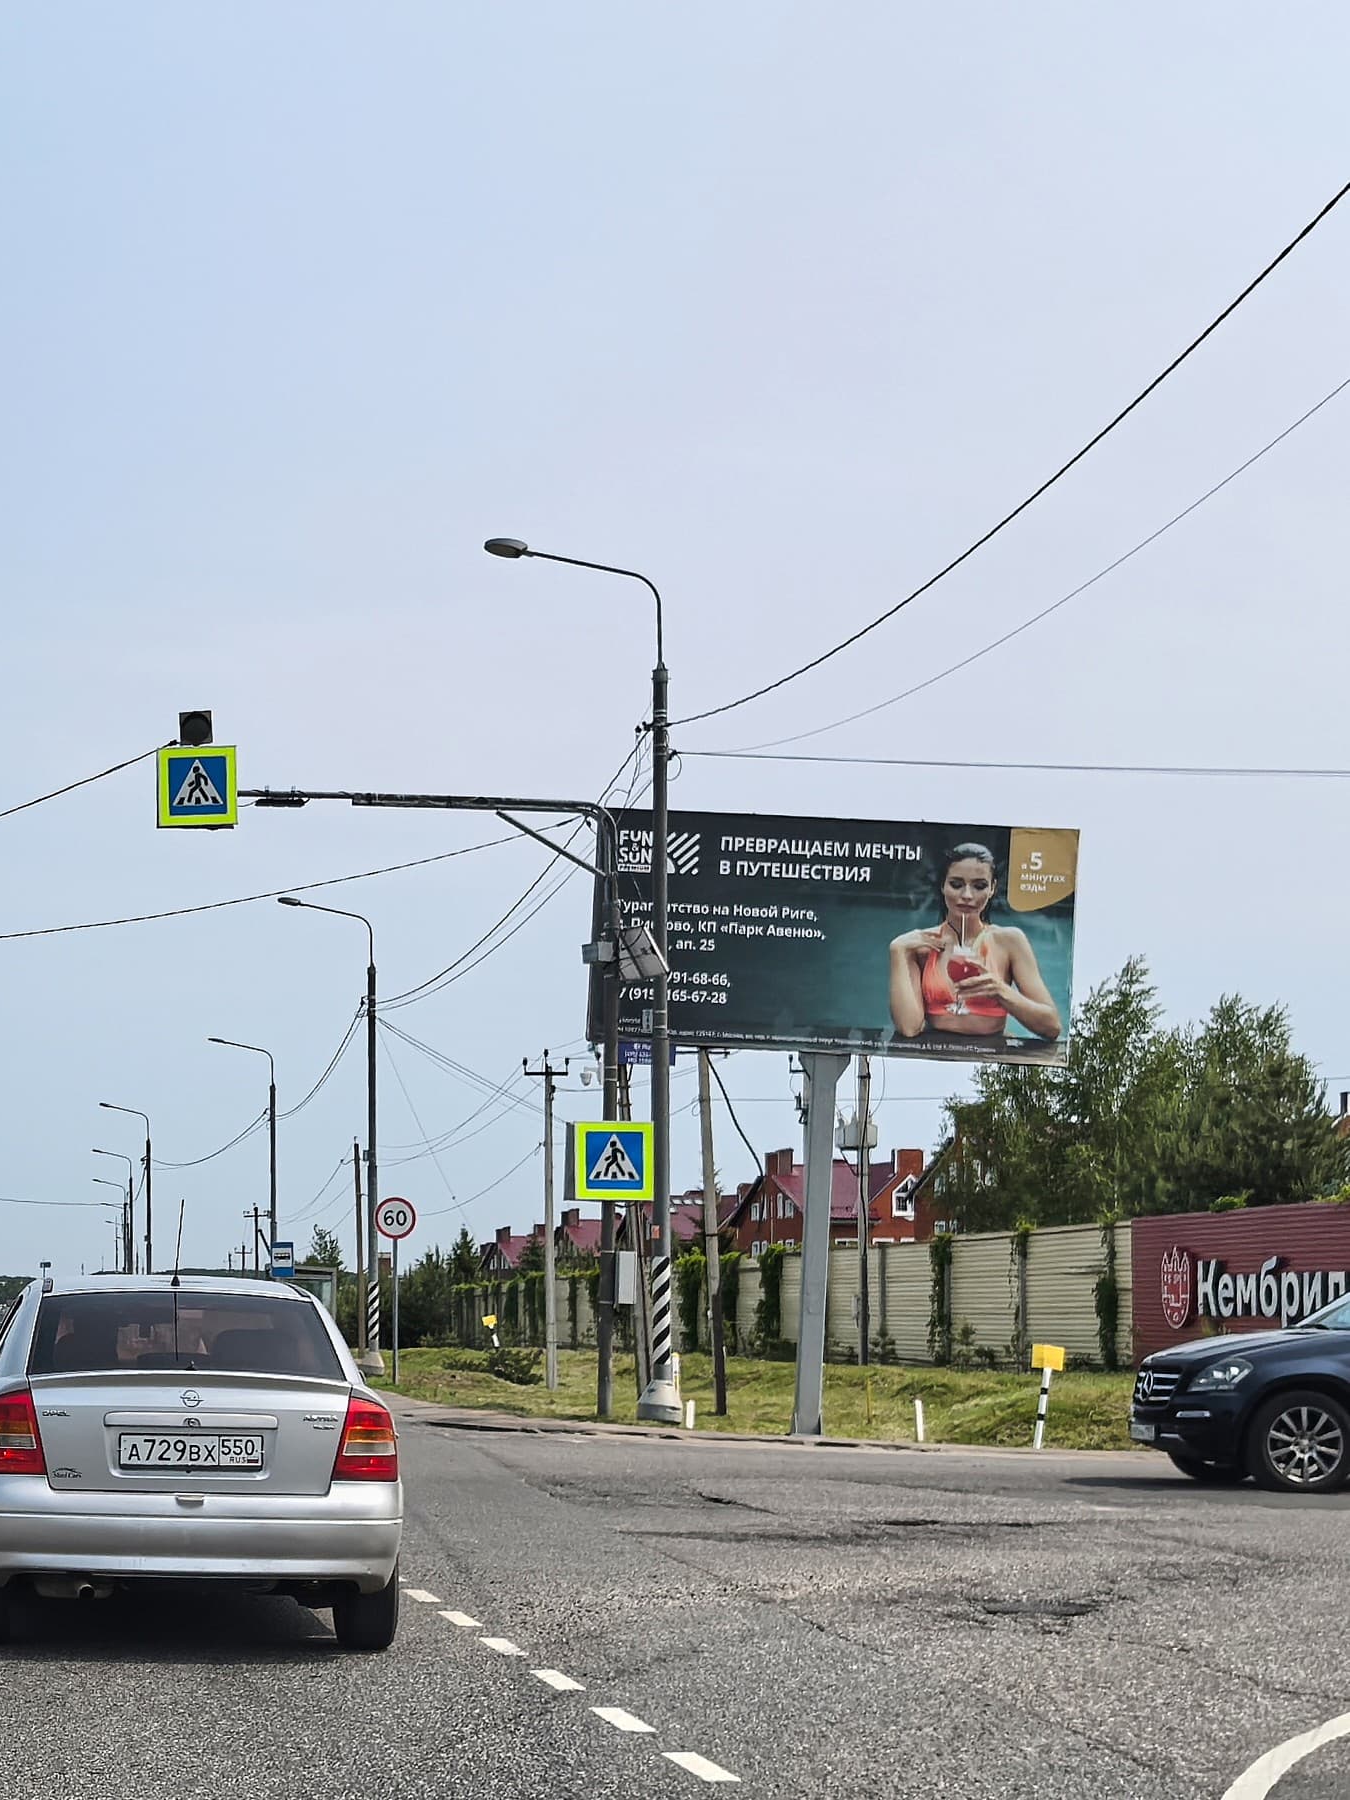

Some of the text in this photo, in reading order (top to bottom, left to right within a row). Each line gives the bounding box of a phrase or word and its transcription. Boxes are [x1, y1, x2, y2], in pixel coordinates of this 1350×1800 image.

[619, 830, 653, 847] FUN
[618, 847, 652, 864] SUN
[720, 836, 922, 861] ПРЕВРАЩАЕМ МЕЧТЫ
[1030, 852, 1043, 870] 5
[719, 860, 871, 882] В ПУТЕШЕСТВИЯ
[712, 904, 729, 916] на
[733, 903, 778, 918] Новой
[782, 908, 818, 922] Риге,
[698, 920, 716, 933] КП
[720, 923, 763, 938] «Парк
[767, 925, 827, 940] Авеню»,
[676, 939, 716, 951] ап. 25
[384, 1210, 407, 1226] 60
[221, 1439, 255, 1456] 550
